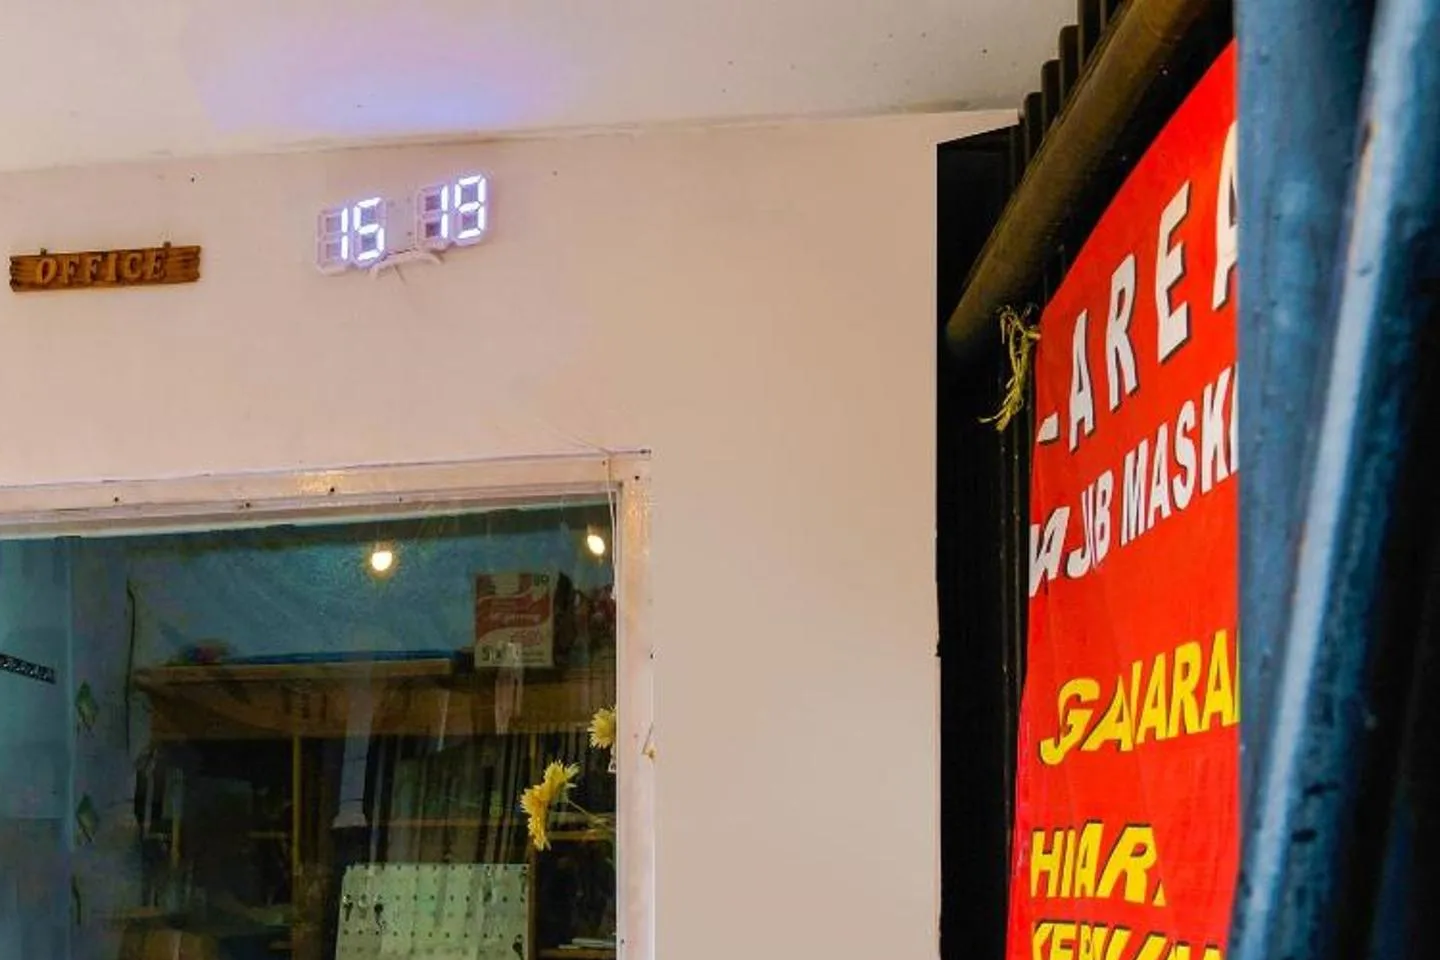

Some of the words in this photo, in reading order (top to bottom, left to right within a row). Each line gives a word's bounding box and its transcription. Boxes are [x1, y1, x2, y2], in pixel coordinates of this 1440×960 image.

[440, 175, 486, 240] 19
[36, 251, 166, 285] OFFICE
[1120, 362, 1239, 547] MASK
